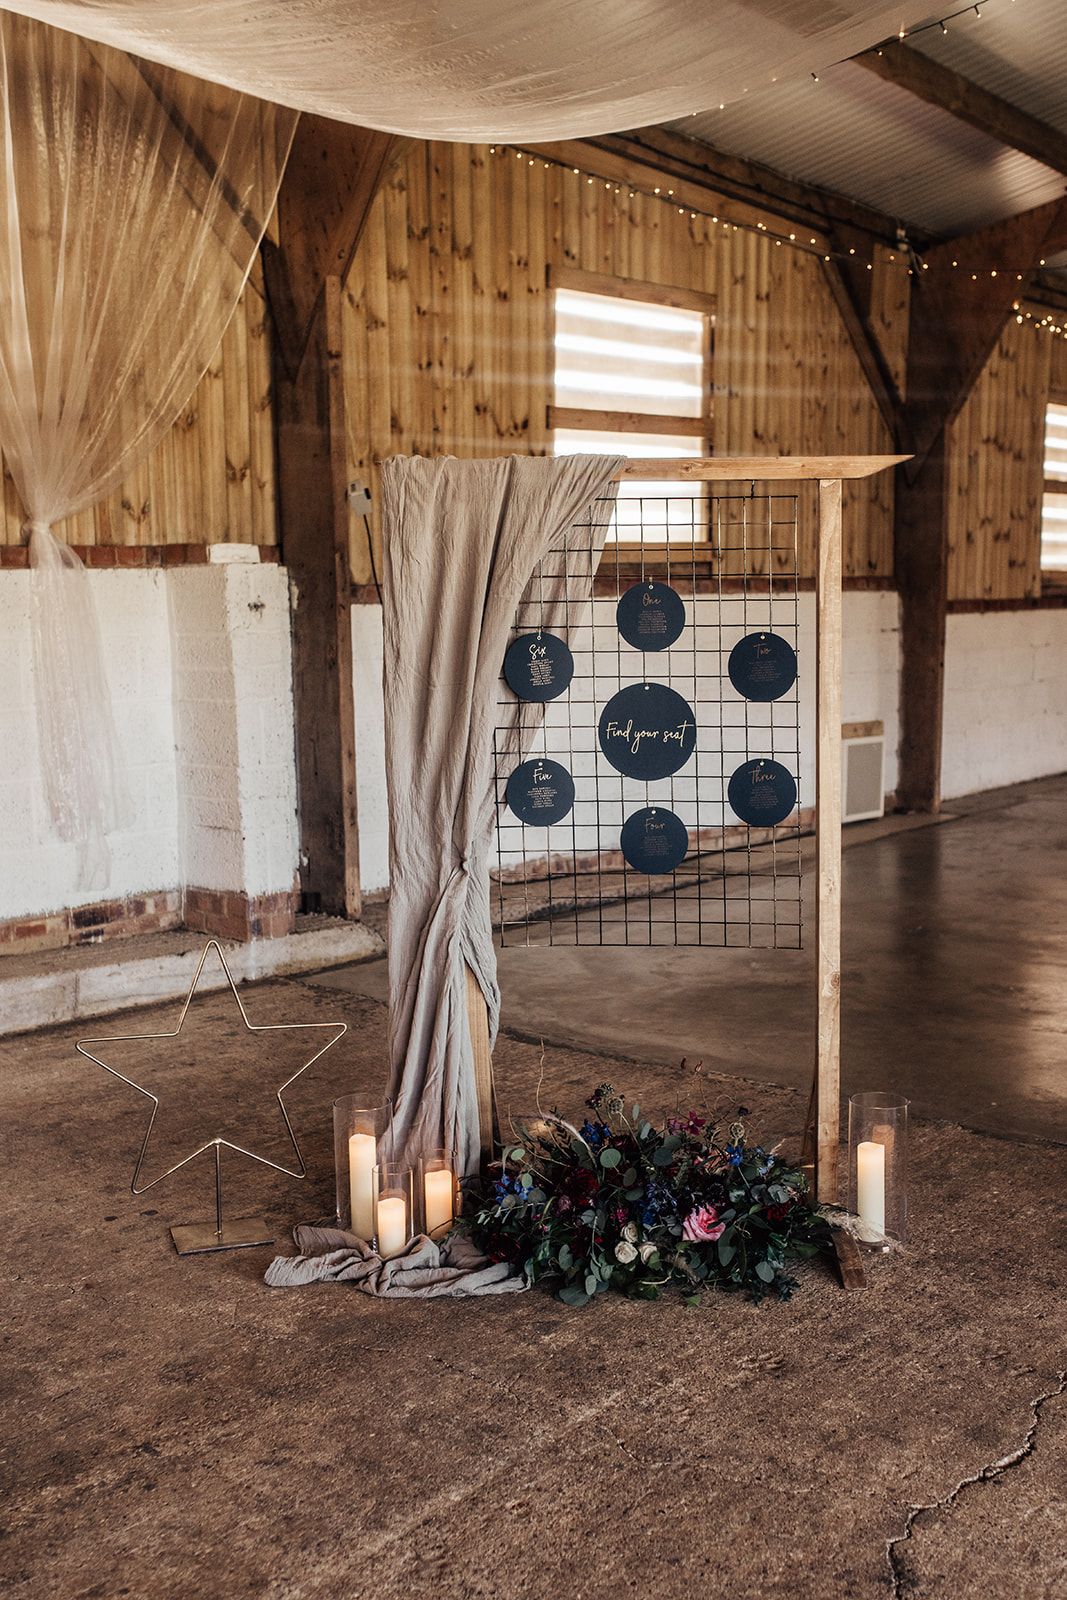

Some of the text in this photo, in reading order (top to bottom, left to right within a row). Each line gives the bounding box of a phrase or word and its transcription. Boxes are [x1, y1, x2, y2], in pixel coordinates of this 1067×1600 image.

[642, 592, 661, 607] One
[529, 643, 547, 660] Six
[753, 643, 771, 658] Two
[606, 719, 694, 754] Find your seat
[533, 767, 552, 784] Five
[748, 766, 776, 785] Three
[644, 816, 666, 833] Four
